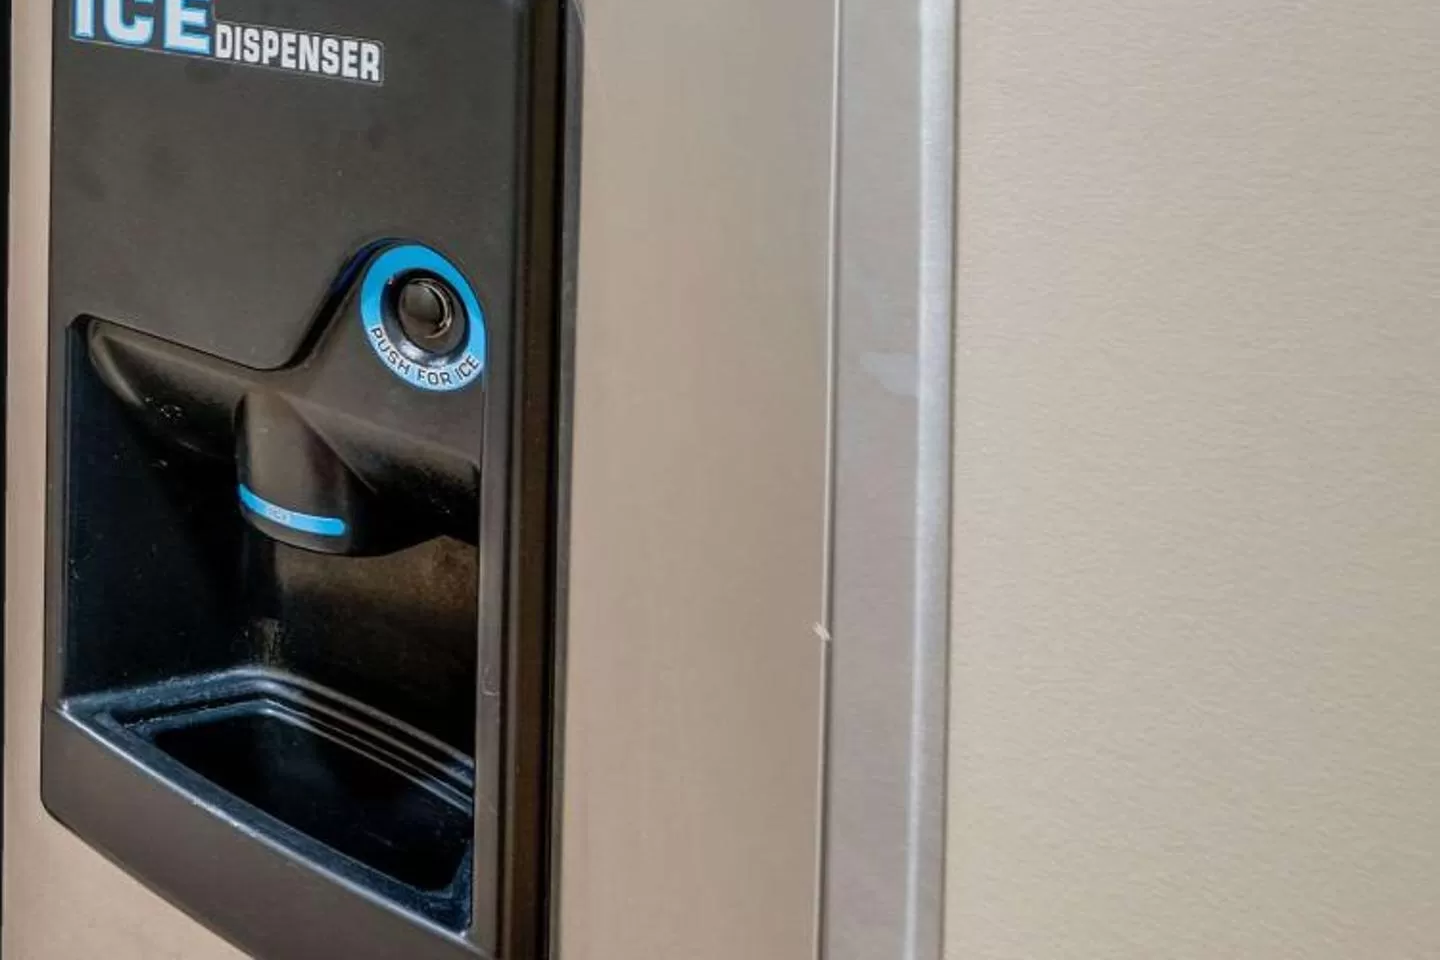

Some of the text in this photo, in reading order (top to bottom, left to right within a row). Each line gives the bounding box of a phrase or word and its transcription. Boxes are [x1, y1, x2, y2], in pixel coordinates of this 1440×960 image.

[215, 23, 381, 82] DISPENSER
[370, 326, 480, 385] PUSH FOR ICE
